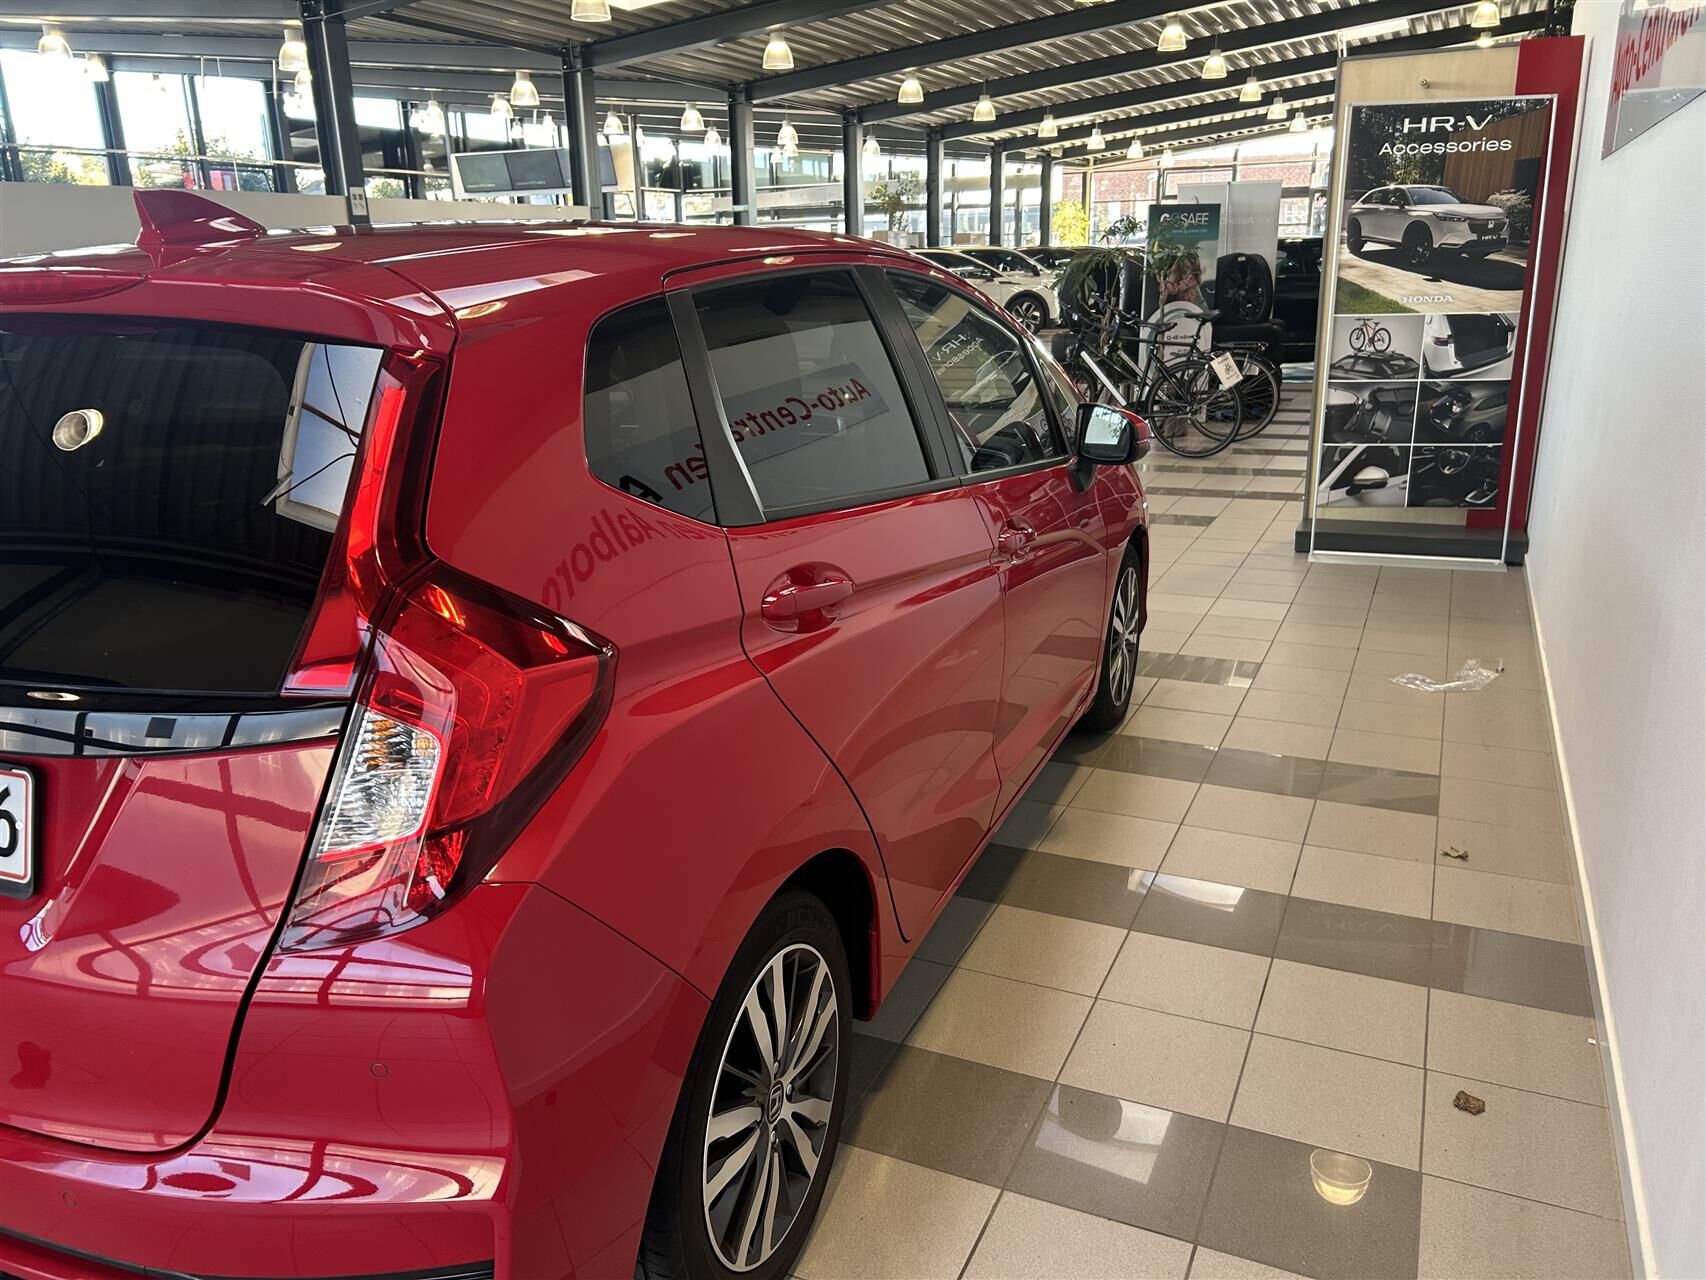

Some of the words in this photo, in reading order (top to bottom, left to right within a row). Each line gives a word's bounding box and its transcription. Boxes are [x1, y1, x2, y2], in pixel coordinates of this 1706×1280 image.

[1403, 114, 1493, 134] HR-V
[1379, 137, 1512, 156] Accessories
[1402, 295, 1454, 304] HONDA
